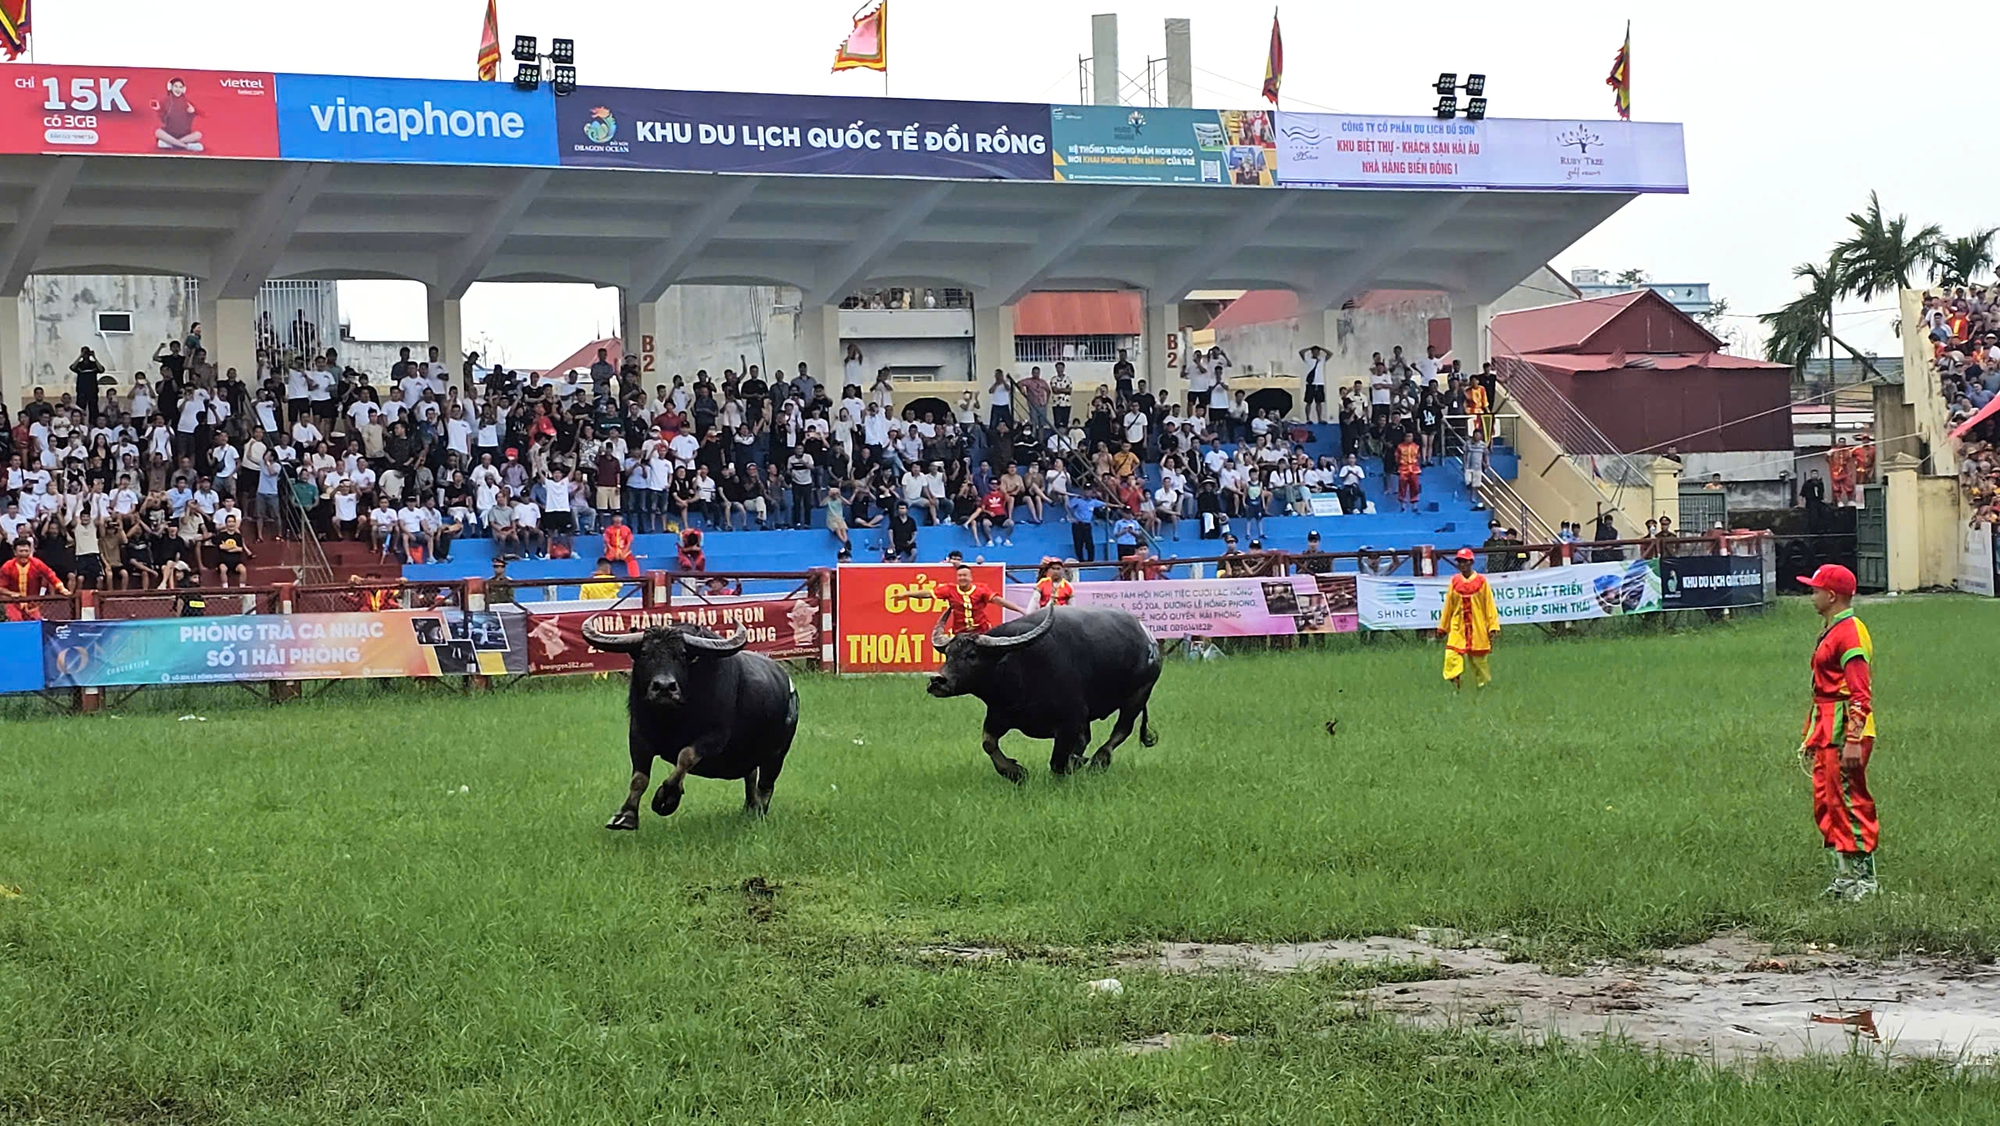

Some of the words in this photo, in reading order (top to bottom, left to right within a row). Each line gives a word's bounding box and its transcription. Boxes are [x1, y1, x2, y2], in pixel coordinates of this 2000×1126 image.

[219, 78, 265, 89] viettel
[42, 76, 132, 112] 15K
[64, 115, 98, 128] 3GB
[309, 97, 525, 142] vinaphone
[1341, 121, 1364, 132] CÔNG
[1366, 123, 1375, 132] TY
[1390, 121, 1412, 133] PHẦN
[1414, 124, 1425, 133] DU
[1427, 124, 1444, 136] LỊCH
[1458, 125, 1475, 135] SƠN
[636, 121, 692, 144] KHU
[698, 123, 735, 146] DU
[742, 125, 801, 151] LỊCH
[807, 120, 882, 150] QUỐC
[887, 122, 920, 151] TẾ
[925, 124, 969, 152] ĐỒI
[975, 125, 1046, 155] RỒNG
[1337, 140, 1354, 152] KHU
[1357, 138, 1375, 155] BIỆT
[1402, 139, 1430, 154] KHÁCH
[1433, 141, 1450, 156] SẠN
[1362, 158, 1380, 173] NHÀ
[1382, 159, 1405, 174] HÀNG
[1518, 583, 1549, 599] PHÁT
[1551, 578, 1584, 597] TRIỂN
[1682, 576, 1698, 588] KHU
[1699, 576, 1709, 588] DU
[1709, 574, 1726, 590] LỊCH
[1092, 592, 1118, 600] TRUNG
[1150, 611, 1168, 621] NGÔ
[1377, 609, 1418, 619] SHINEC
[1541, 602, 1568, 615] SINH
[593, 612, 625, 632] NHÀ
[630, 610, 673, 628] HÀNG
[677, 609, 717, 626] TRÂU
[723, 606, 764, 624] NGON
[180, 621, 254, 643] PHÒNG
[256, 619, 296, 641] TRÀ
[298, 622, 327, 640] CA
[329, 621, 384, 643] NHẠC
[726, 625, 777, 644] PÒNG
[1147, 624, 1168, 633] TLINE
[846, 628, 925, 664] THOÁT
[206, 643, 236, 667] SỐ
[238, 648, 248, 666] 1
[251, 643, 286, 666] HẢI
[289, 643, 362, 664] PHÒNG
